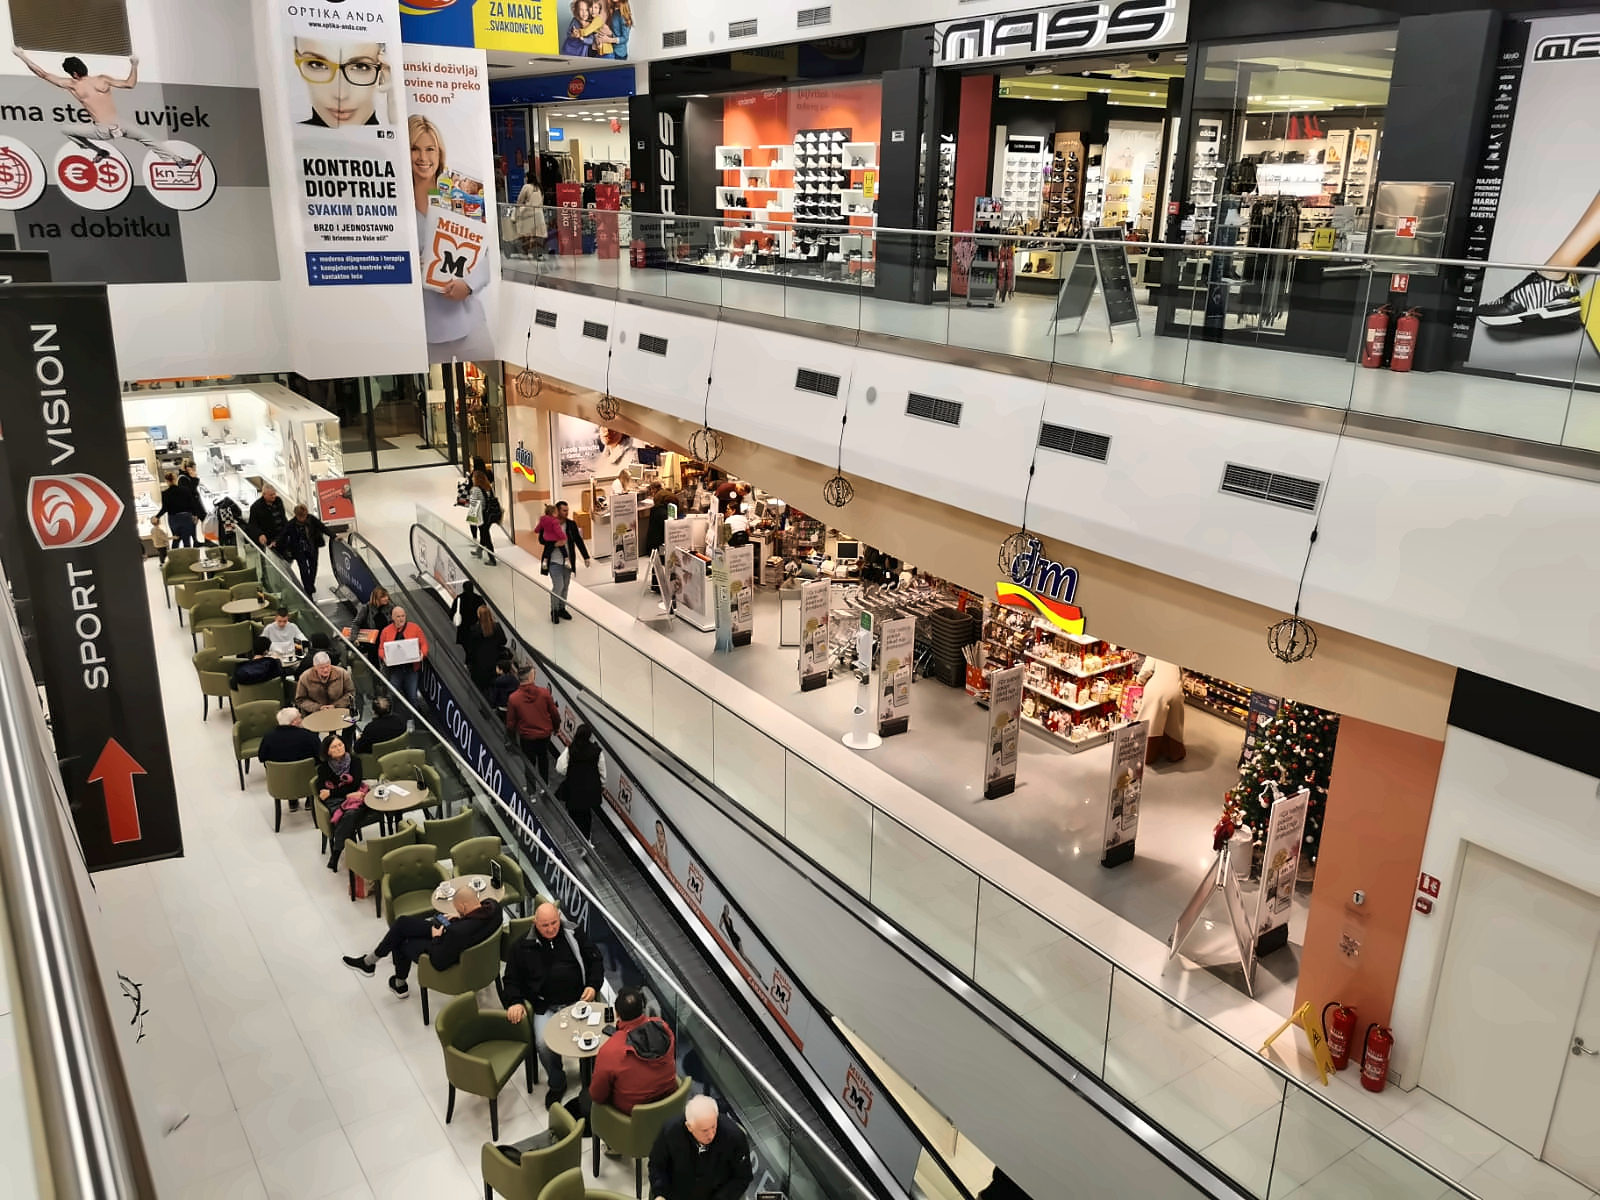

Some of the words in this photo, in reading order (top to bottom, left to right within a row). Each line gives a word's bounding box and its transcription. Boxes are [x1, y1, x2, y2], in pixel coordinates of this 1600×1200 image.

[288, 5, 341, 19] OPTIKA
[346, 11, 384, 24] ANDA
[489, 2, 504, 18] ZA
[508, 3, 543, 22] MANJE
[308, 21, 367, 32] www.optika-anda.com
[941, 0, 1177, 61] MASS
[434, 63, 479, 78] doživljaj
[404, 79, 434, 90] ovine
[435, 82, 449, 90] na
[450, 81, 481, 94] preko
[413, 92, 439, 104] 1600
[135, 105, 210, 133] uvijek
[302, 158, 396, 178] KONTROLA
[305, 180, 397, 199] DIOPTRIJE
[307, 203, 352, 217] SVAKIM
[356, 203, 398, 217] DANOM
[1472, 198, 1498, 206] MARKI
[28, 220, 62, 238] na
[71, 216, 171, 239] dobitku
[313, 223, 335, 232] BRZO
[336, 223, 340, 232] I
[341, 223, 394, 232] JEDNOSTAVNO
[436, 216, 484, 243] Müller
[440, 251, 467, 278] M
[30, 323, 76, 466] VISION
[1010, 537, 1079, 604] dm
[65, 562, 109, 690] SPORT
[446, 699, 474, 761] COOL
[478, 744, 503, 797] KAO
[775, 984, 786, 1003] M
[850, 1085, 864, 1112] M
